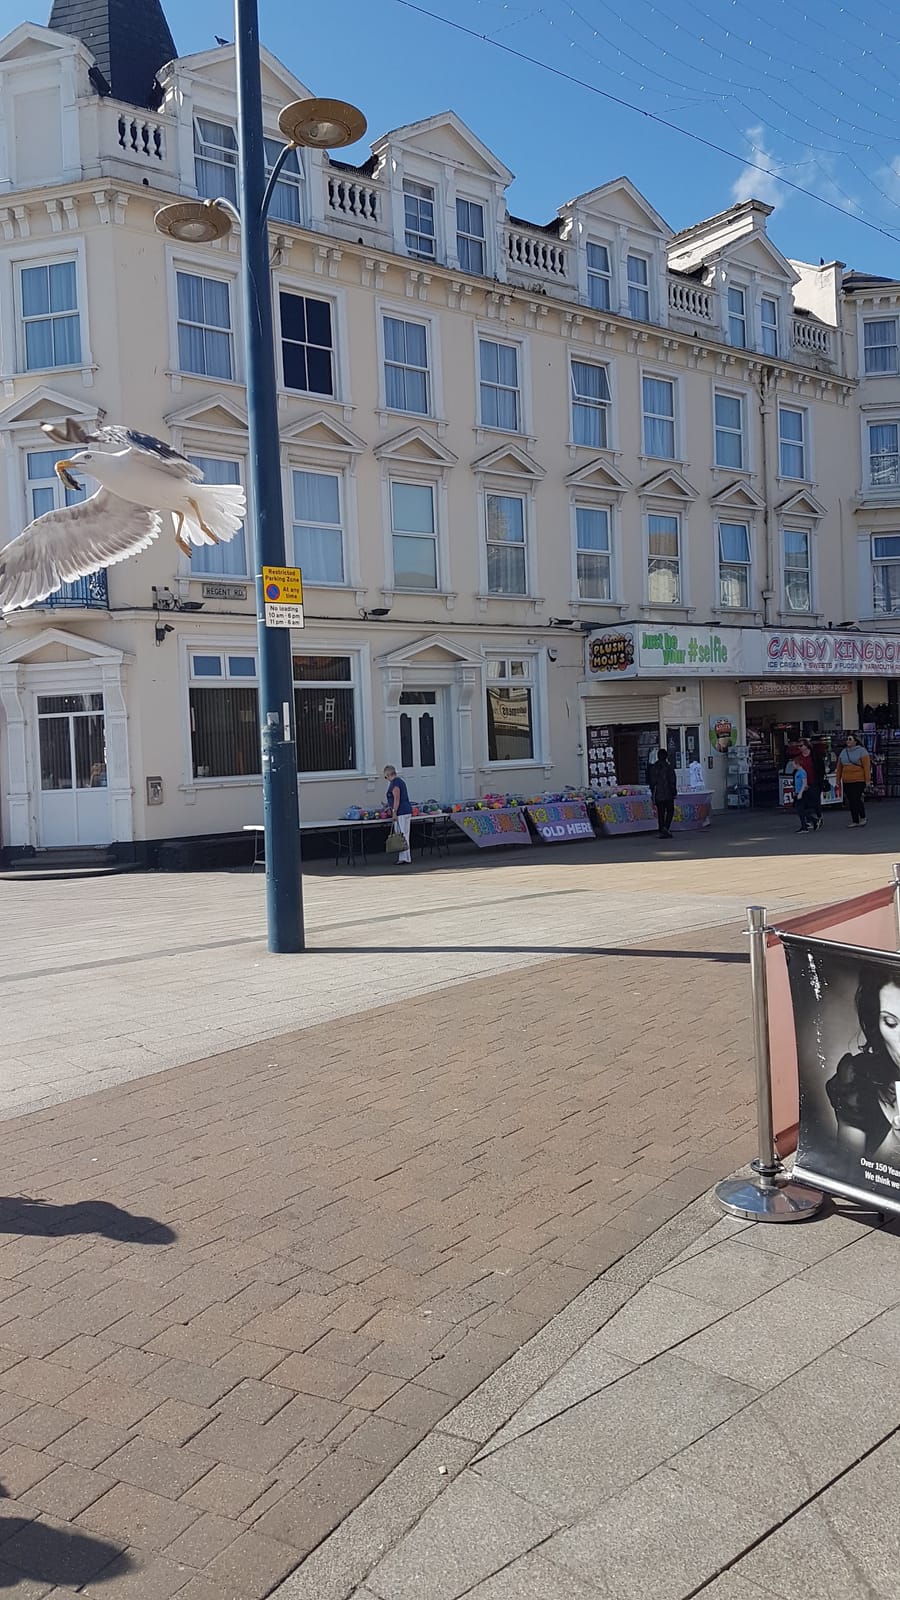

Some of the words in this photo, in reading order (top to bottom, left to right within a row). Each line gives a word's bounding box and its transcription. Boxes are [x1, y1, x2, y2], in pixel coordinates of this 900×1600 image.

[264, 575, 286, 583] Parking
[206, 587, 231, 596] REGENT
[279, 605, 298, 613] loading
[593, 641, 625, 655] PLUSH
[664, 632, 678, 650] be
[767, 637, 827, 660] CANDY
[663, 649, 686, 665] your
[688, 635, 728, 663] #selfie
[593, 652, 626, 667] MOJI'S
[780, 661, 801, 669] CREAM
[861, 1157, 874, 1169] Over
[875, 1162, 887, 1173] 150
[865, 1170, 874, 1181] We
[875, 1175, 890, 1186] think
